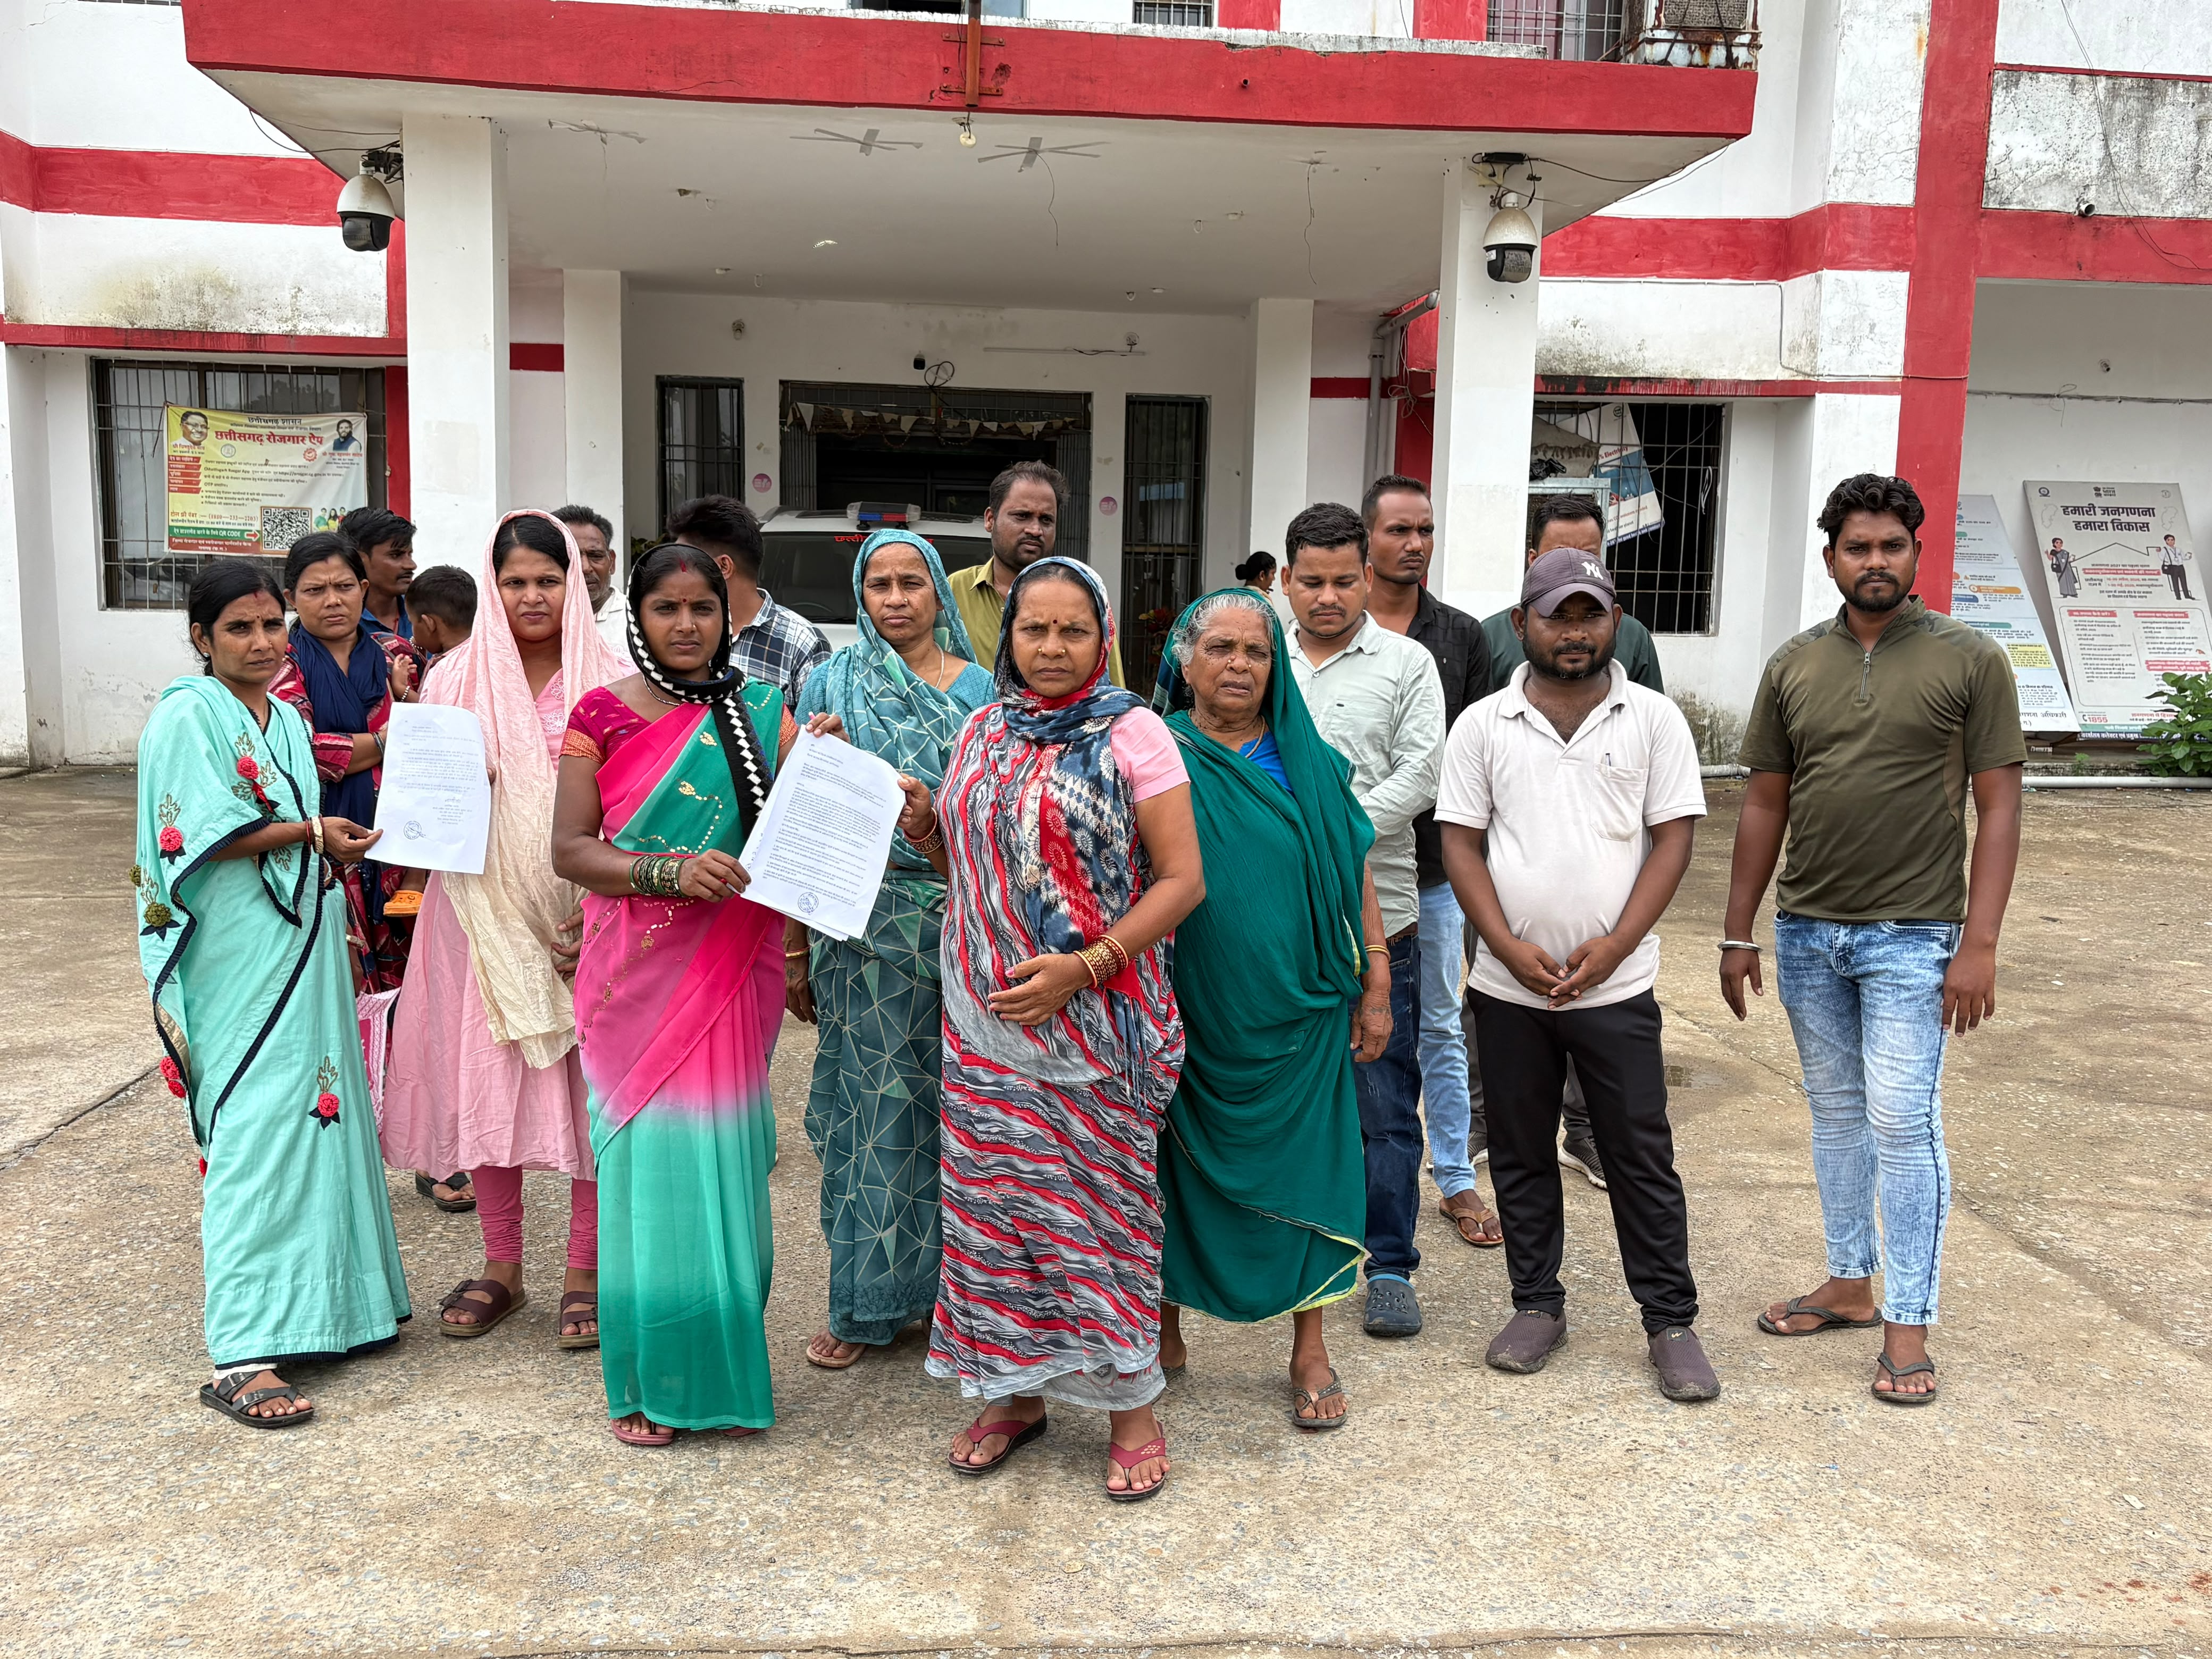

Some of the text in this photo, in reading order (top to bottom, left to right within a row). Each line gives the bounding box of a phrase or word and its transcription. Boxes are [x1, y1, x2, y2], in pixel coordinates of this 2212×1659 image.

[248, 416, 279, 426] छत्तीसगढ़
[215, 429, 324, 446] छत्तीसगढ़ रोजगार ऐप
[2060, 503, 2156, 517] हमारी जनगणना
[2073, 518, 2150, 532] हमारा विकास
